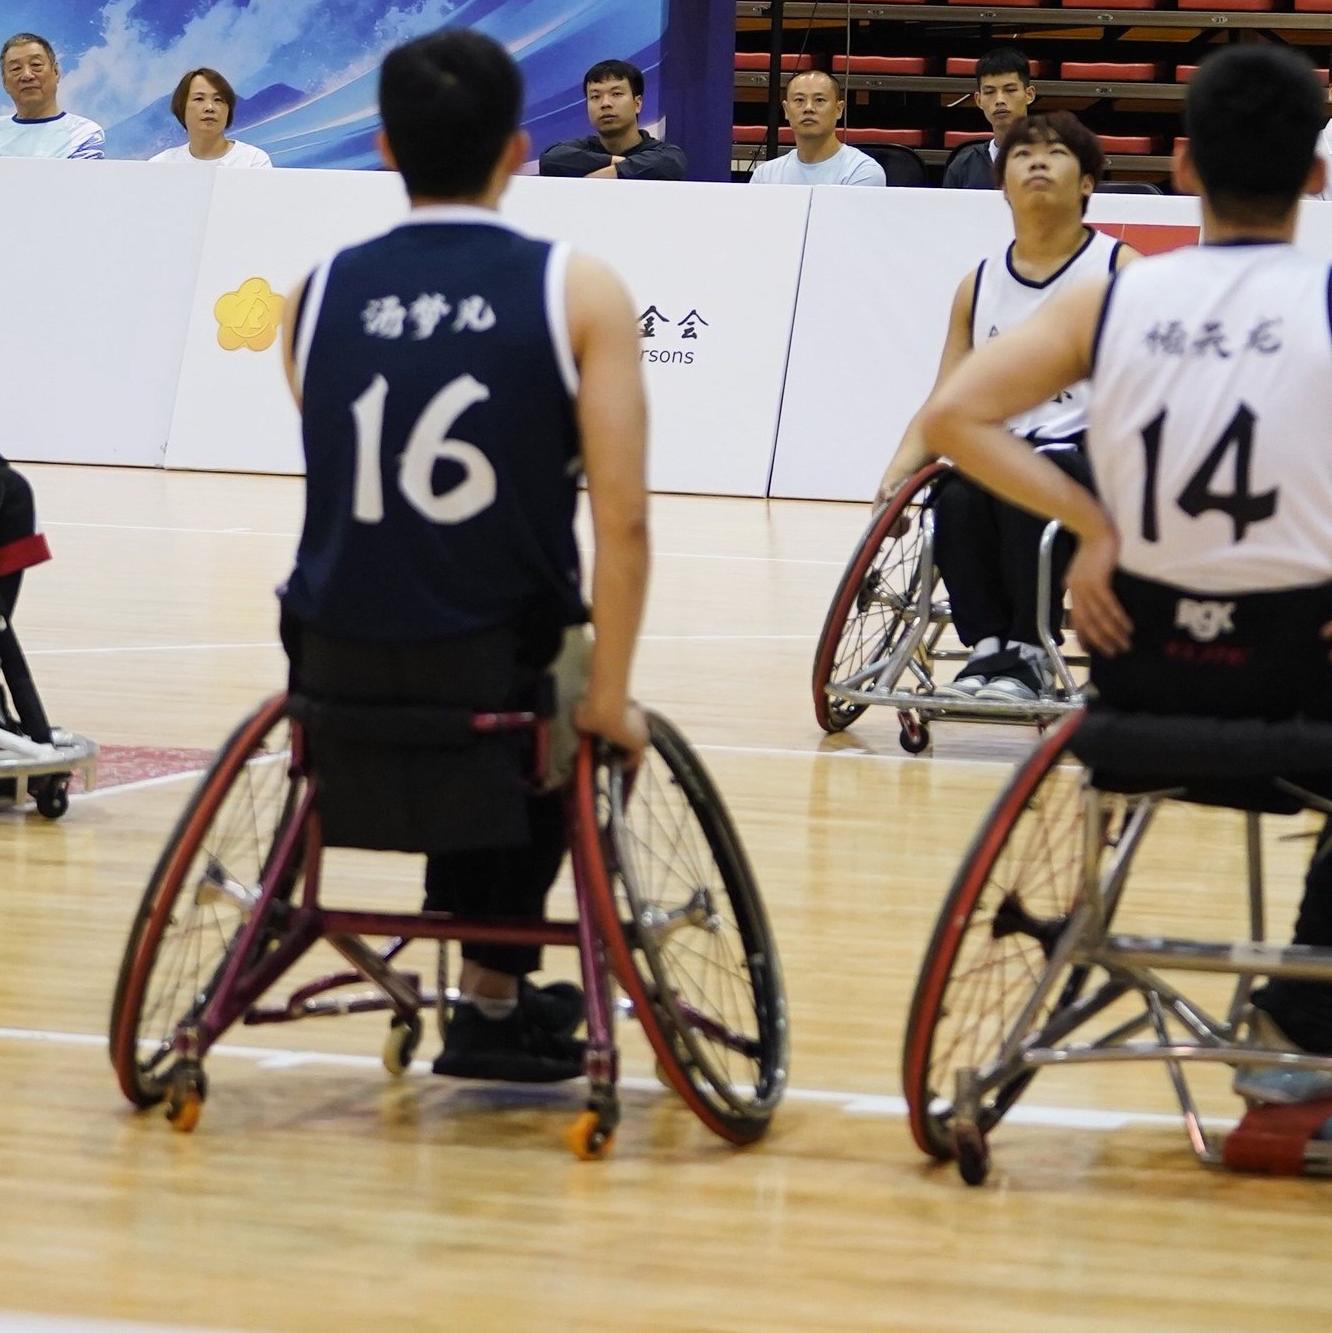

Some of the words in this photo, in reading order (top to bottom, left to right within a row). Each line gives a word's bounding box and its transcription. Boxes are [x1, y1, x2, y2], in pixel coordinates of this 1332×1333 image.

[637, 305, 709, 339] 金会
[350, 373, 498, 525] 16
[1140, 401, 1280, 544] 14
